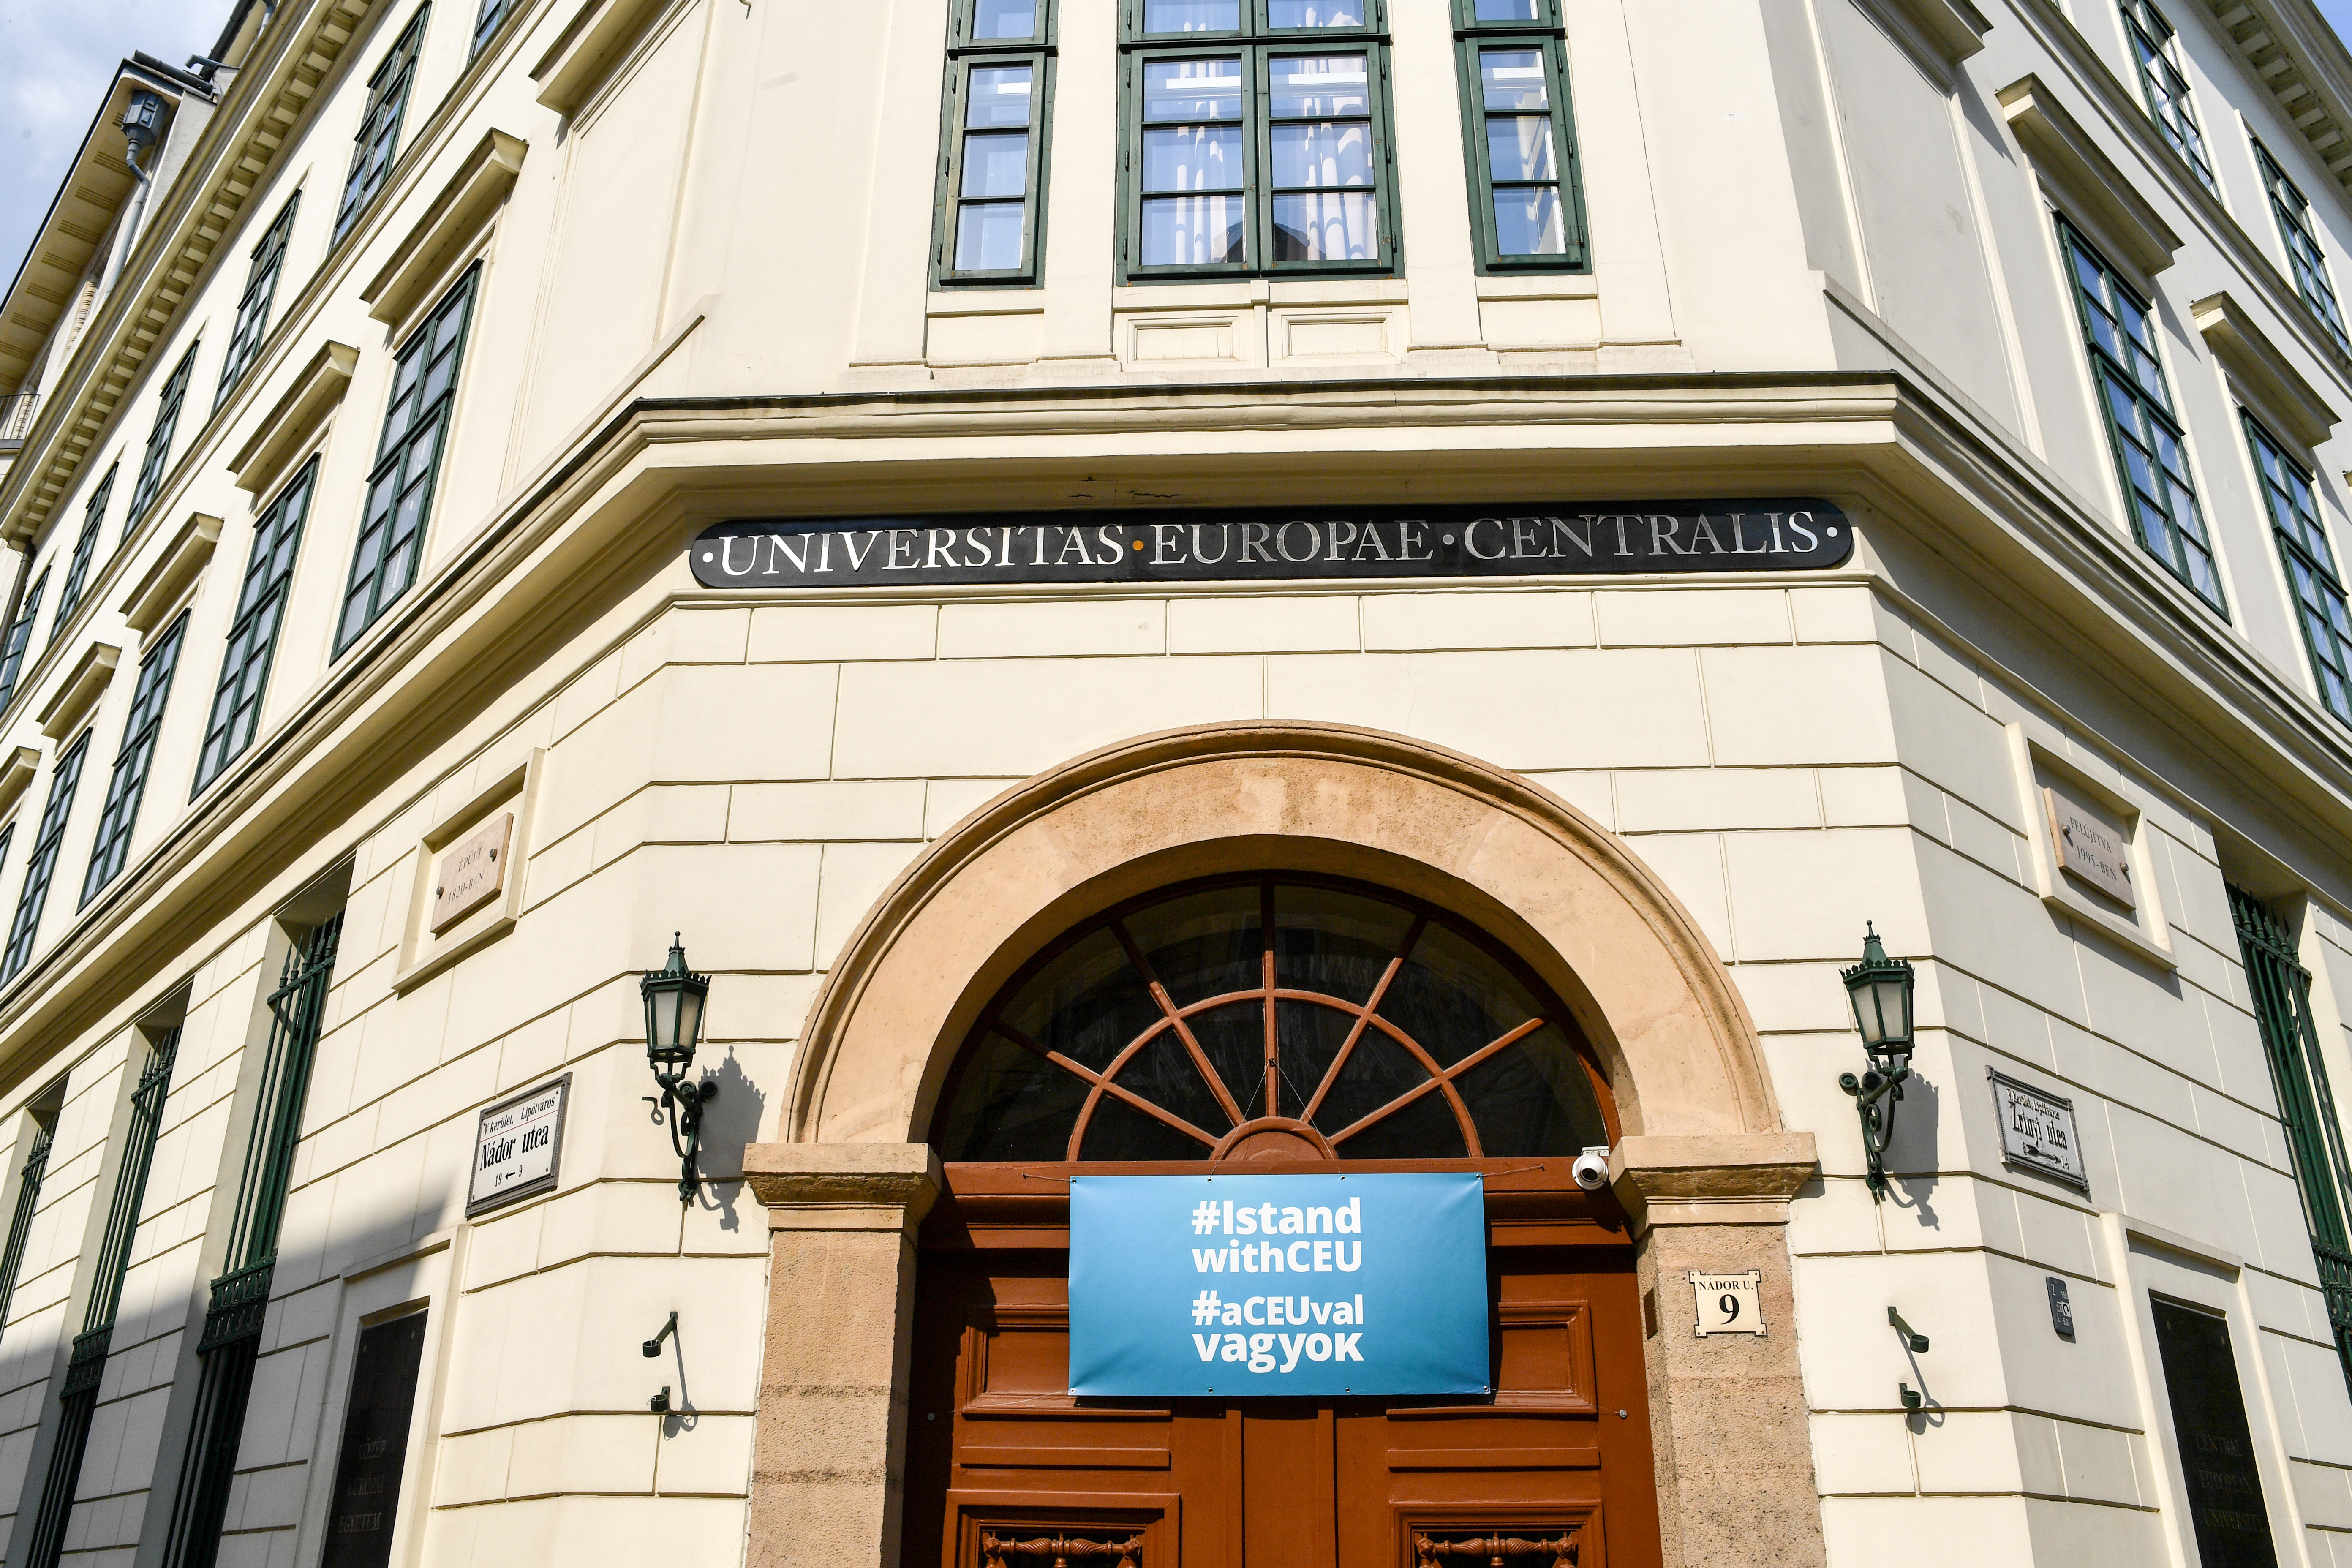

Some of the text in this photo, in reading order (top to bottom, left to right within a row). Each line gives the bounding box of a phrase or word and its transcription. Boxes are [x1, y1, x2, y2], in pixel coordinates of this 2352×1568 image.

[719, 511, 1818, 576] UNIVERSITAS EUROPAE CENTRALIS
[2070, 817, 2112, 853] FELÚJÍTVA
[2076, 846, 2117, 881] 1995-BEN
[448, 870, 485, 904] 1820-BAN
[484, 1097, 555, 1135] V. kerület, Lipótváros
[479, 1124, 549, 1171] Nádor utca
[2045, 1119, 2067, 1149] utca
[495, 1165, 523, 1187] 19 9
[1191, 1197, 1361, 1235] #Istand
[1192, 1239, 1362, 1273] withCEU
[1699, 1278, 1753, 1290] NÁDOR U.
[1191, 1290, 1363, 1326] #aCEUval
[1719, 1294, 1740, 1325] 9
[2195, 1433, 2243, 1457] CENTRAL
[2199, 1470, 2254, 1494] EUROPEAN
[338, 1512, 382, 1533] EGYETEM
[2202, 1508, 2263, 1532] UNIVERSITY
